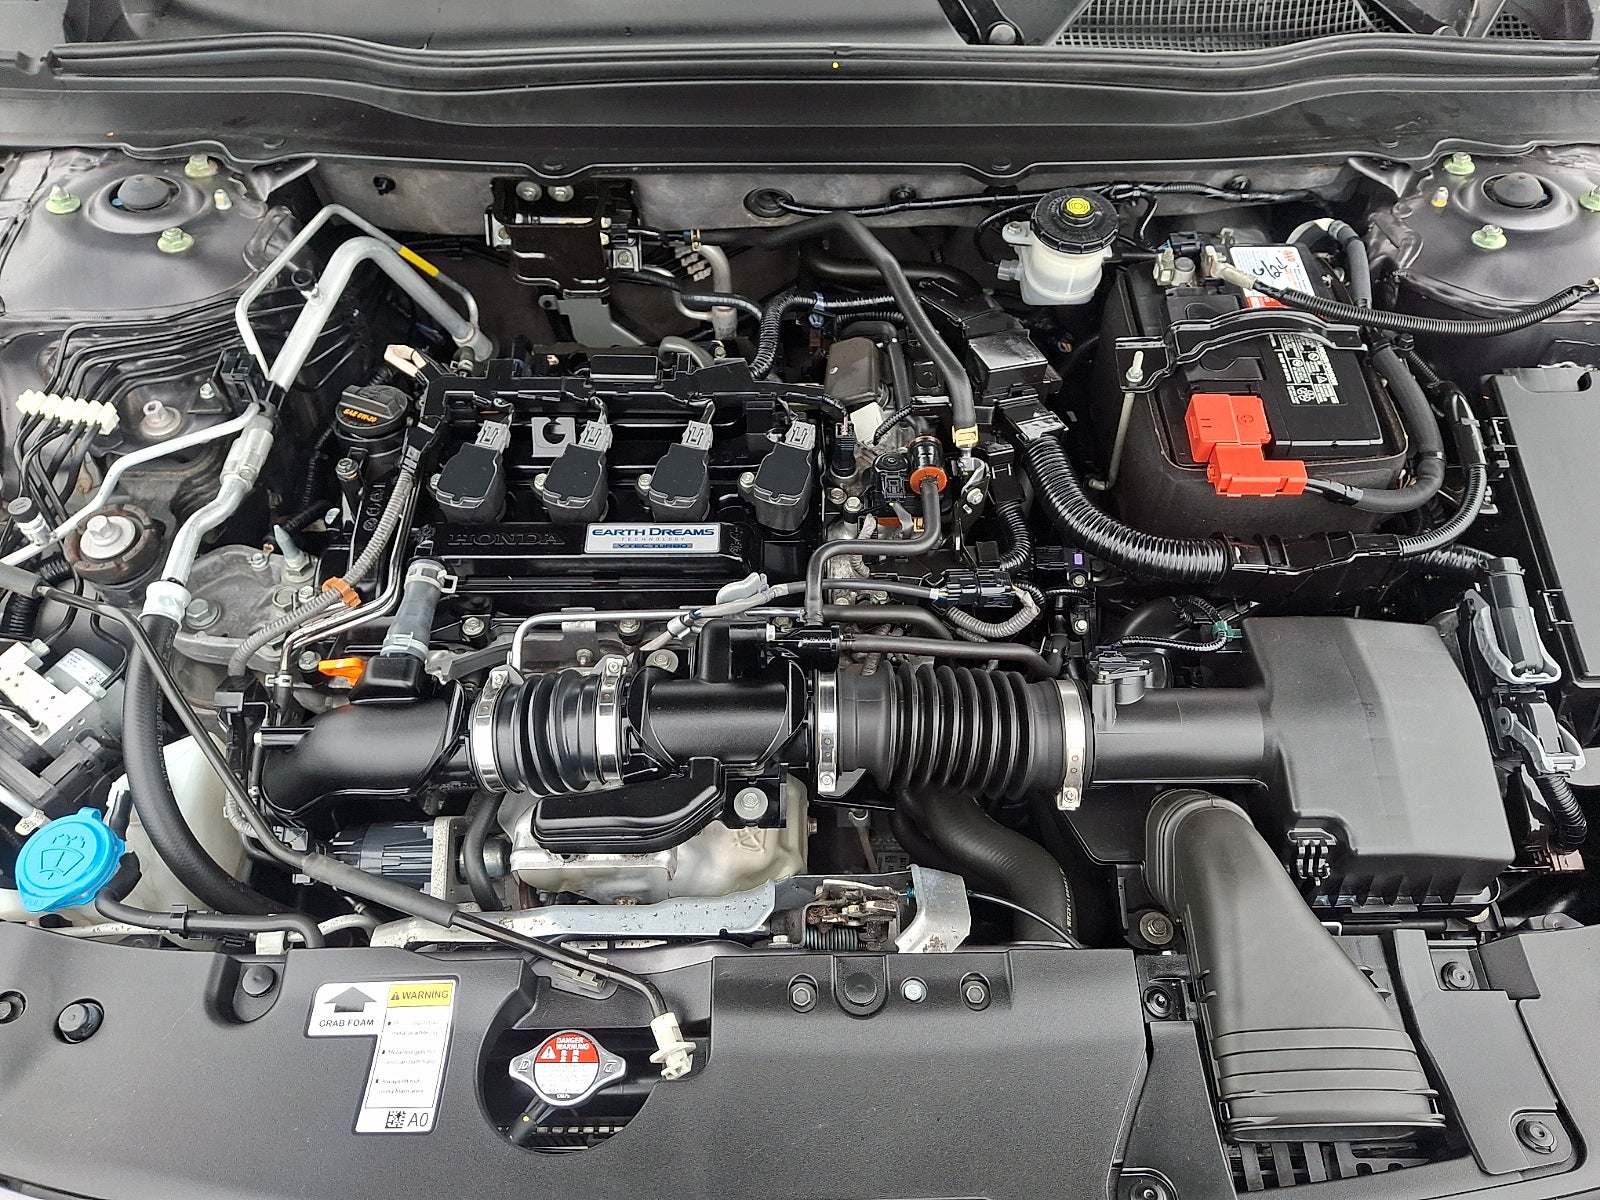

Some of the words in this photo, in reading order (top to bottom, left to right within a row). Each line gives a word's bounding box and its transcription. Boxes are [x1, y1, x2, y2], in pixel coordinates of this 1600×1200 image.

[592, 528, 646, 536] EARTH
[648, 527, 716, 536] DREAMS
[447, 533, 567, 546] HONDA
[401, 990, 449, 1000] WARNING
[318, 1019, 346, 1028] GRAB
[347, 1018, 375, 1027] FOAM
[407, 1112, 429, 1127] A0
